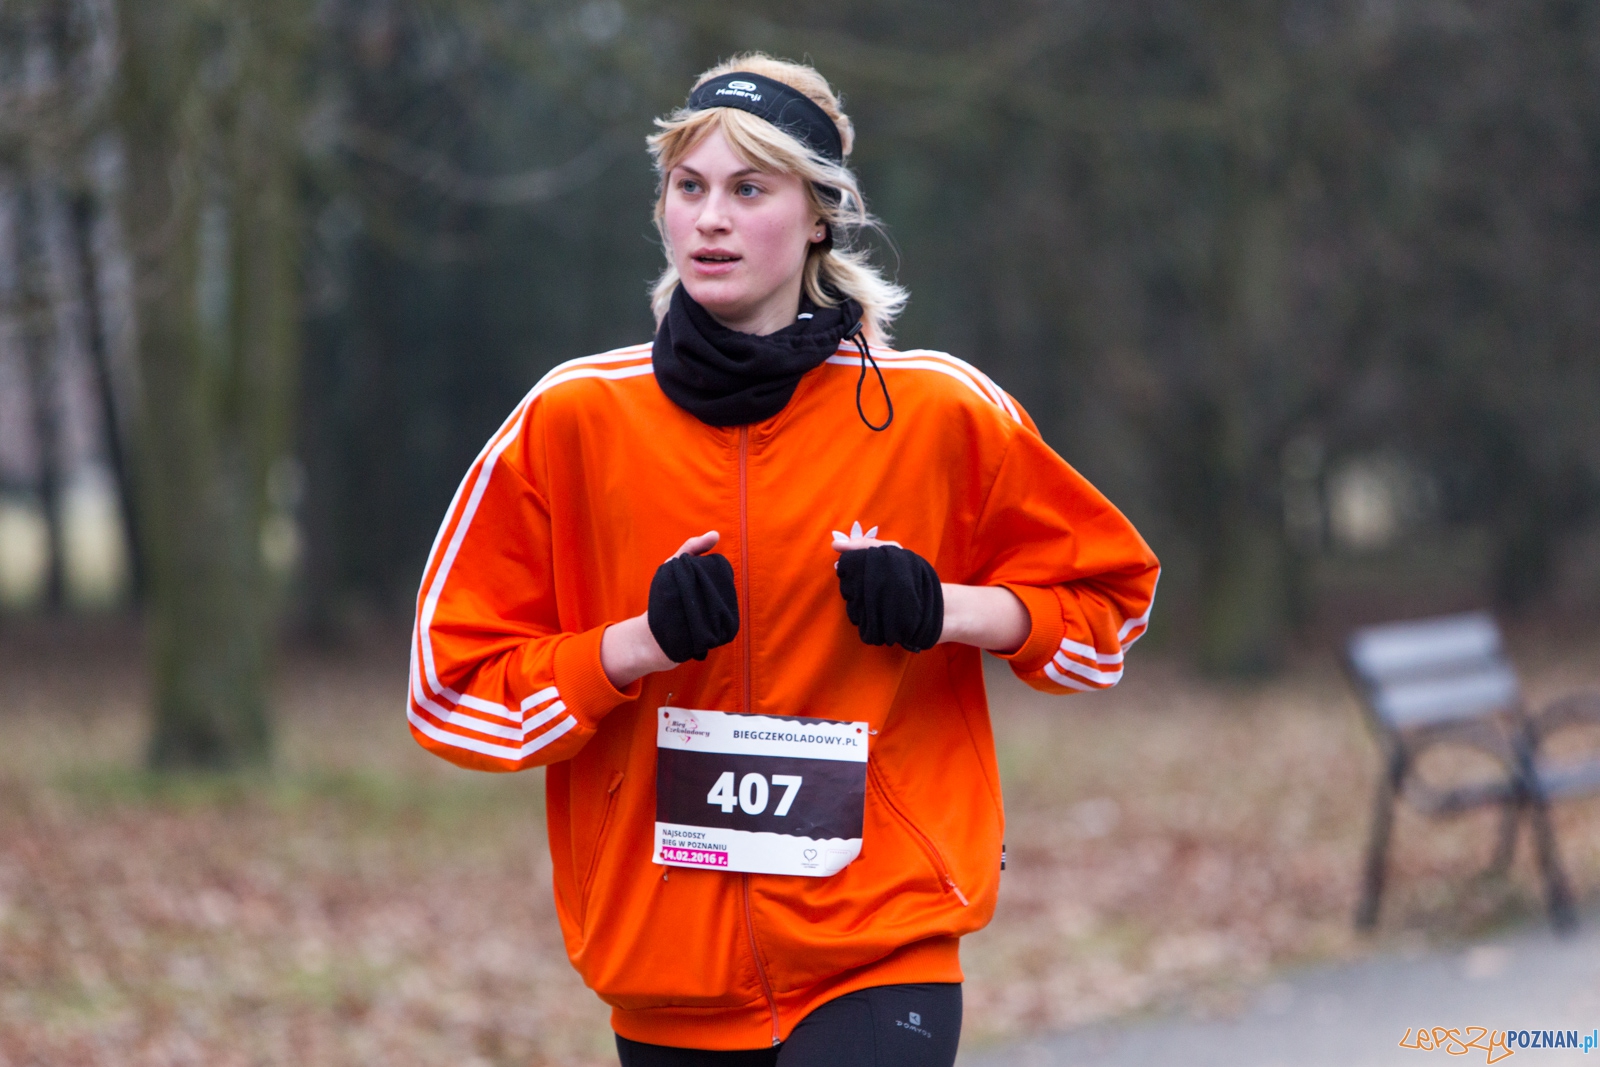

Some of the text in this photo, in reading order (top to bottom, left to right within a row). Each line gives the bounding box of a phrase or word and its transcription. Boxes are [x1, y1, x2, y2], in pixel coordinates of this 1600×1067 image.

[733, 730, 858, 747] BIEGCZEKOLADOWY.PL
[707, 771, 803, 817] 407
[662, 829, 706, 840] NAJSŁODSZY
[662, 838, 677, 846] BIEG
[687, 841, 727, 851] POZNANIU
[662, 849, 728, 866] 14.02.2016 r.
